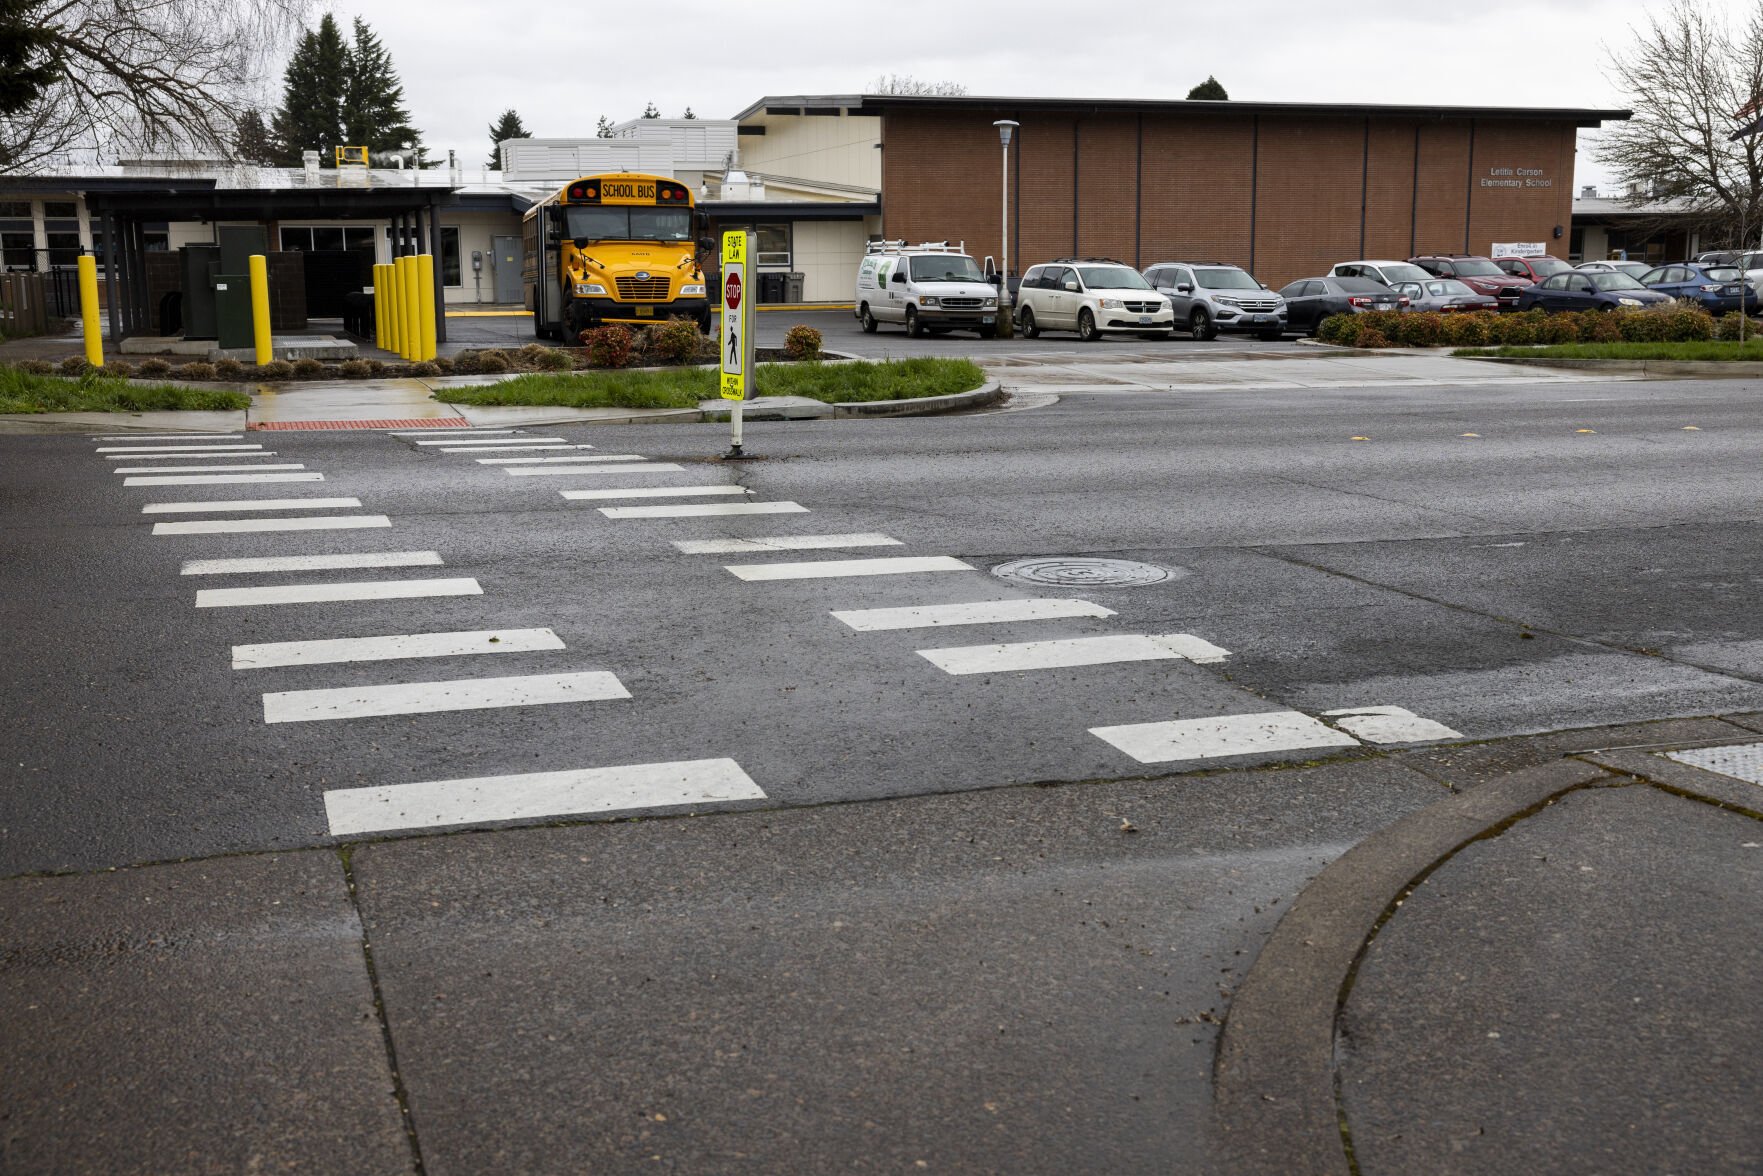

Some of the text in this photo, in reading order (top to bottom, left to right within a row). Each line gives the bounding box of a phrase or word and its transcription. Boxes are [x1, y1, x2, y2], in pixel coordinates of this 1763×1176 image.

[1490, 168, 1542, 176] Letitia Carson
[1480, 178, 1552, 188] Elementary School
[602, 184, 655, 198] SCHOOL BUS
[728, 236, 742, 246] STATE
[728, 250, 740, 259] LAW
[726, 284, 741, 298] STOP
[728, 314, 736, 322] FOR
